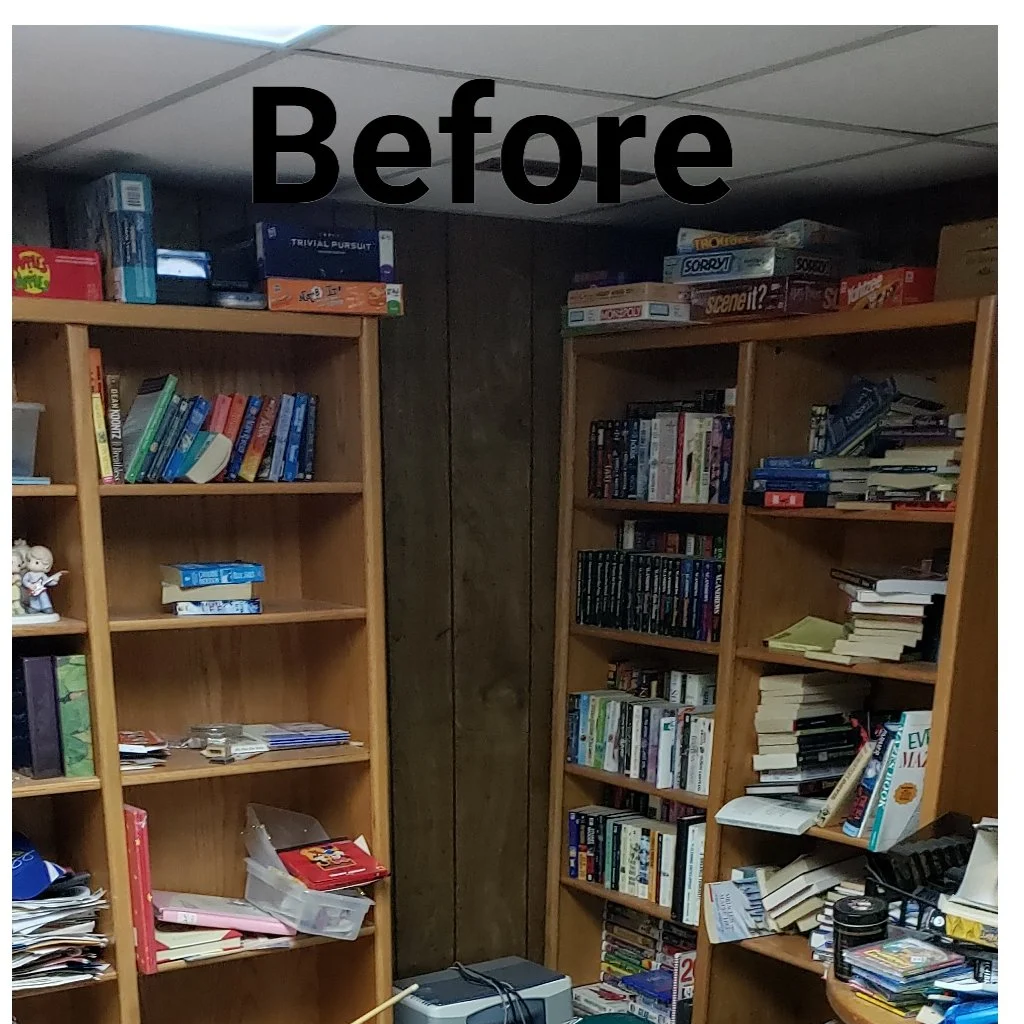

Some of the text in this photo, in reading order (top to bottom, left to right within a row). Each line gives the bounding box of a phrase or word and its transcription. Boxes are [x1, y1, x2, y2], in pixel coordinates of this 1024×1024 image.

[290, 237, 372, 250] TRIVIAL PURSUIT
[681, 253, 733, 275] SORRY!
[846, 270, 884, 305] Yahtzee
[599, 305, 643, 320] MONOPOLY
[111, 407, 121, 439] KOONTZ
